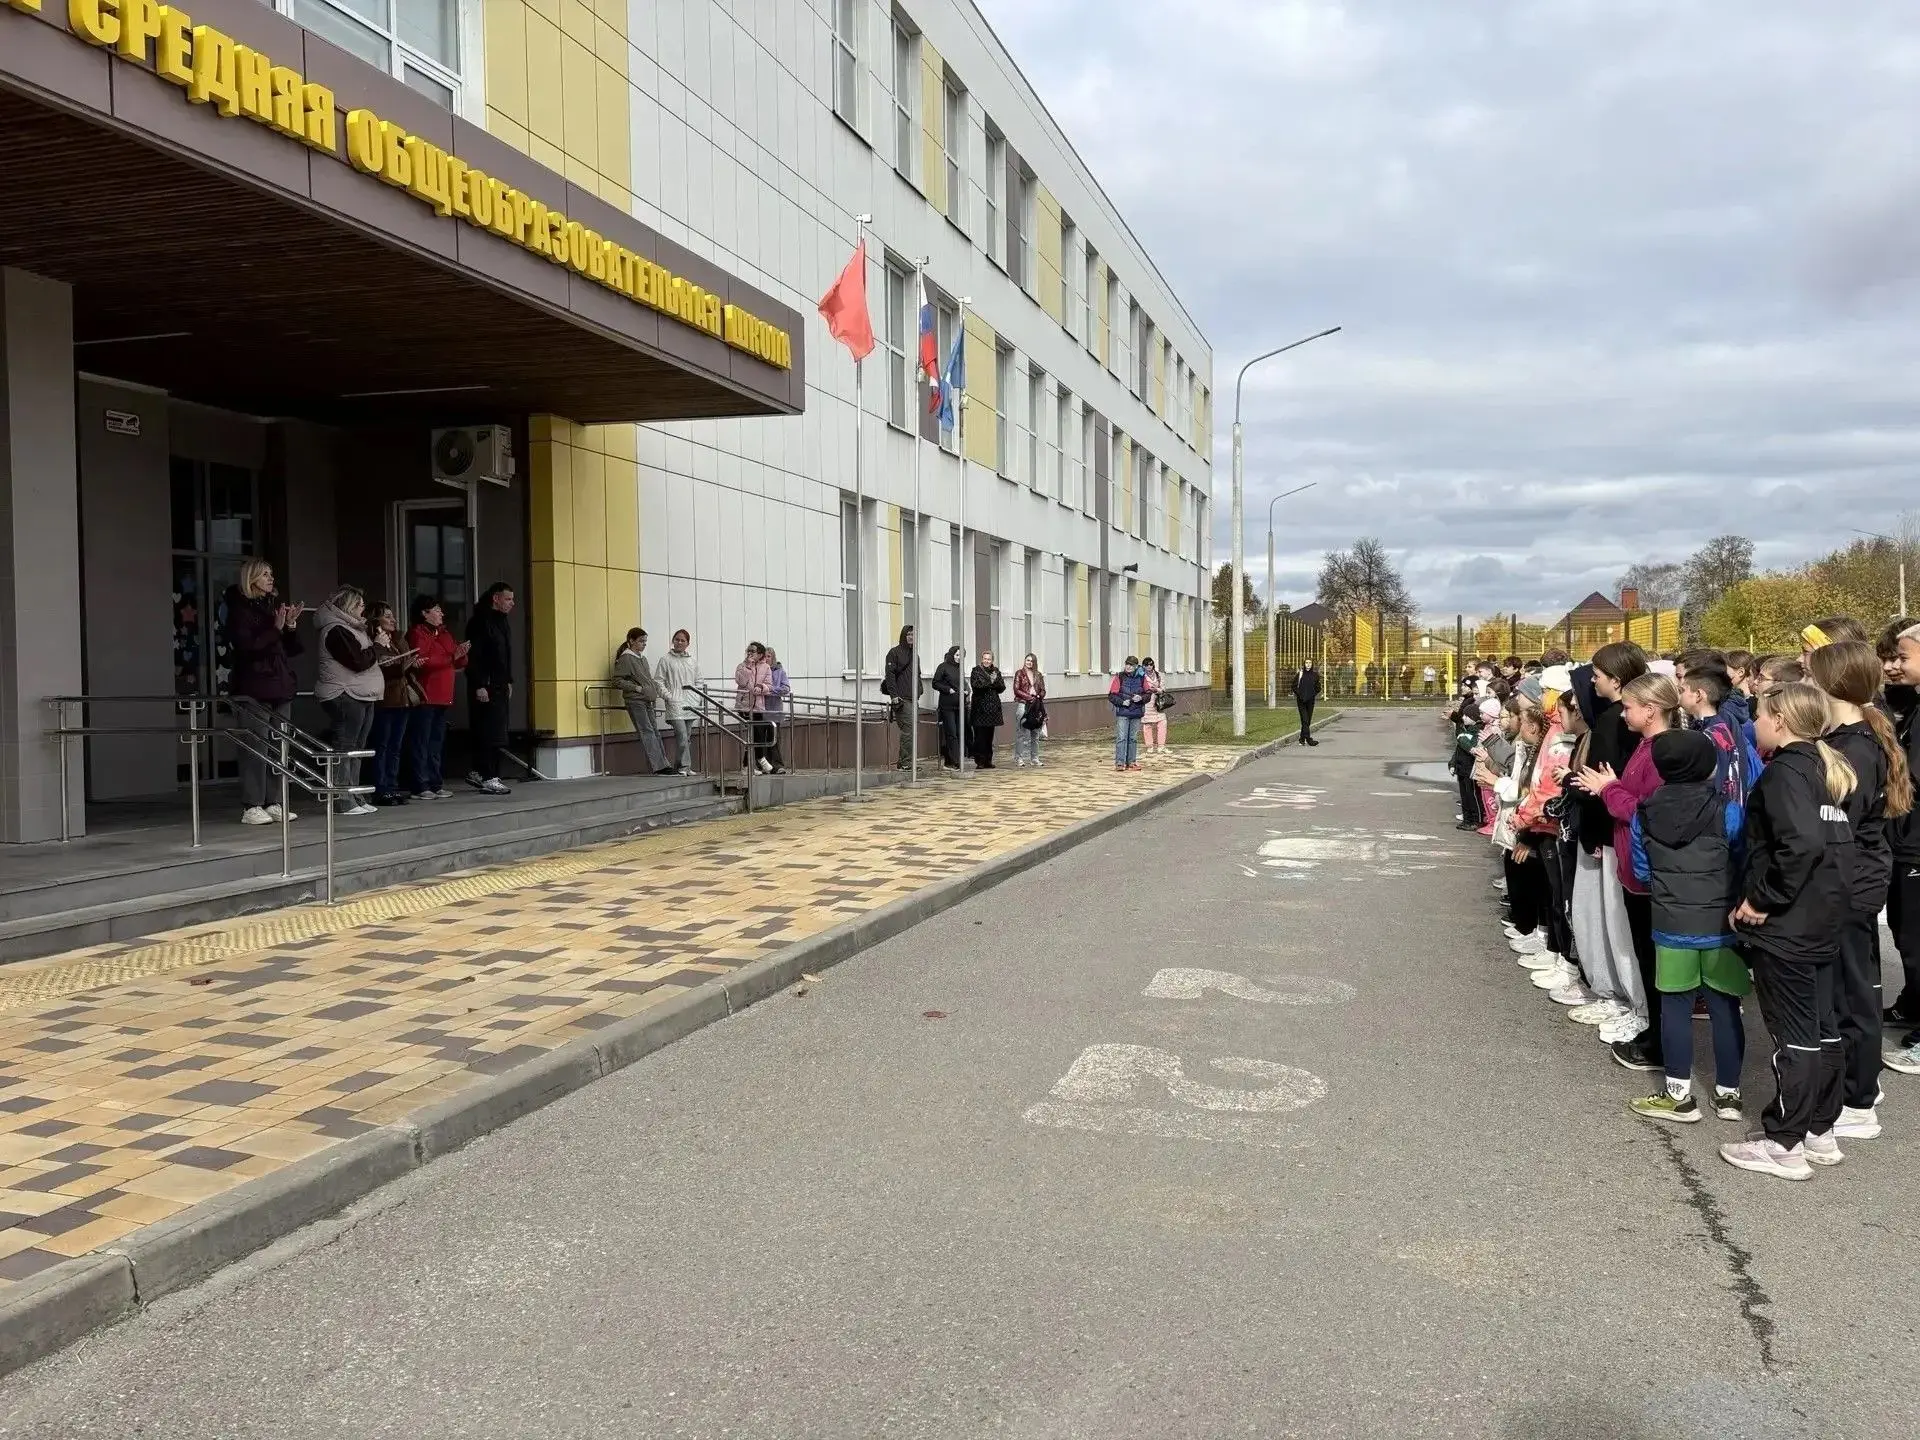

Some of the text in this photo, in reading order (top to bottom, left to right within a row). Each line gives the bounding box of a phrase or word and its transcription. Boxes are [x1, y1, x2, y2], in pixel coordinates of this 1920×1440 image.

[68, 0, 792, 370] СРЕДНЯЯ ОБЩЕОБРАЗОВАТЕЛЬНАЯ ШКОЛА
